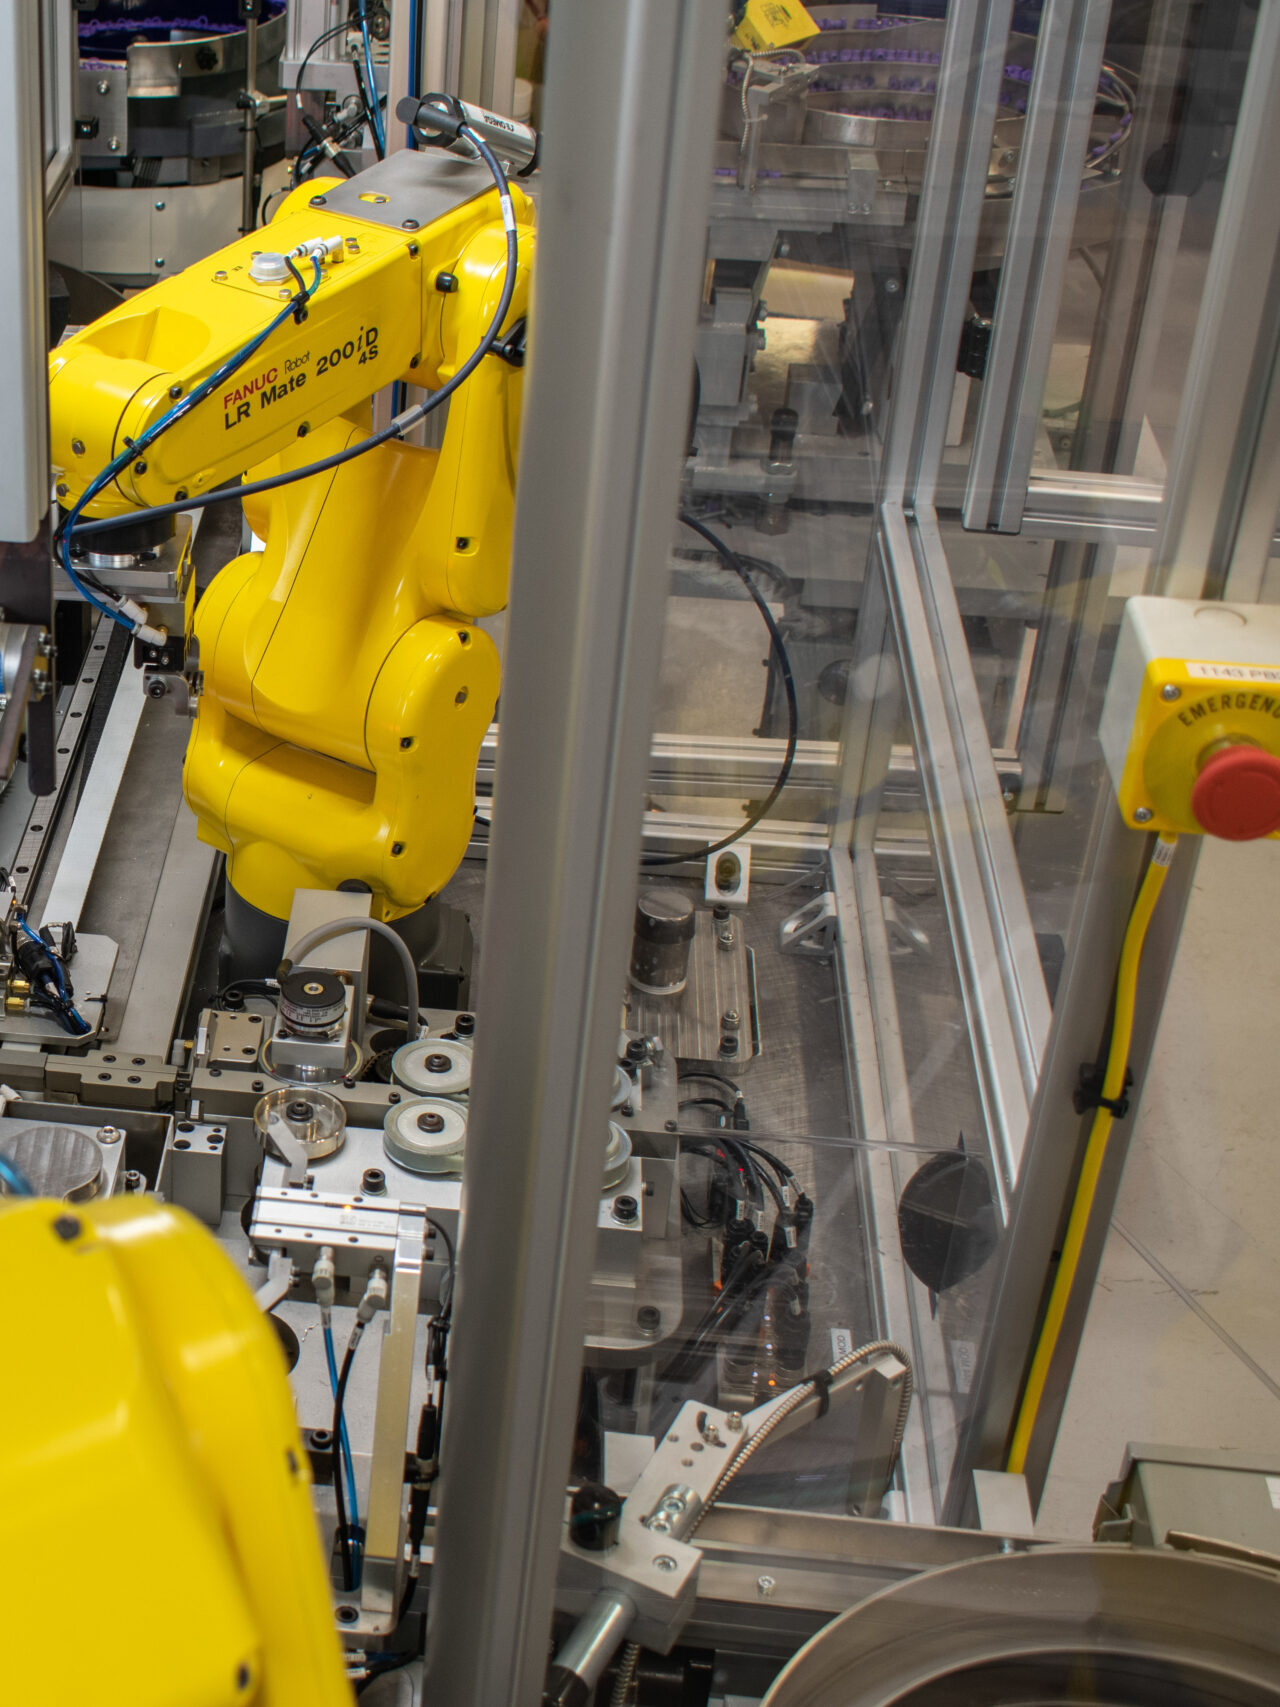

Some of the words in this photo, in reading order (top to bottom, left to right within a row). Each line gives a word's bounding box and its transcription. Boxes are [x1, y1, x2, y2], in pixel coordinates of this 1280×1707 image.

[223, 367, 278, 410] FANUC
[284, 351, 310, 374] Robot
[358, 345, 379, 365] 4S
[224, 401, 252, 430] LR
[260, 372, 307, 409] Mate
